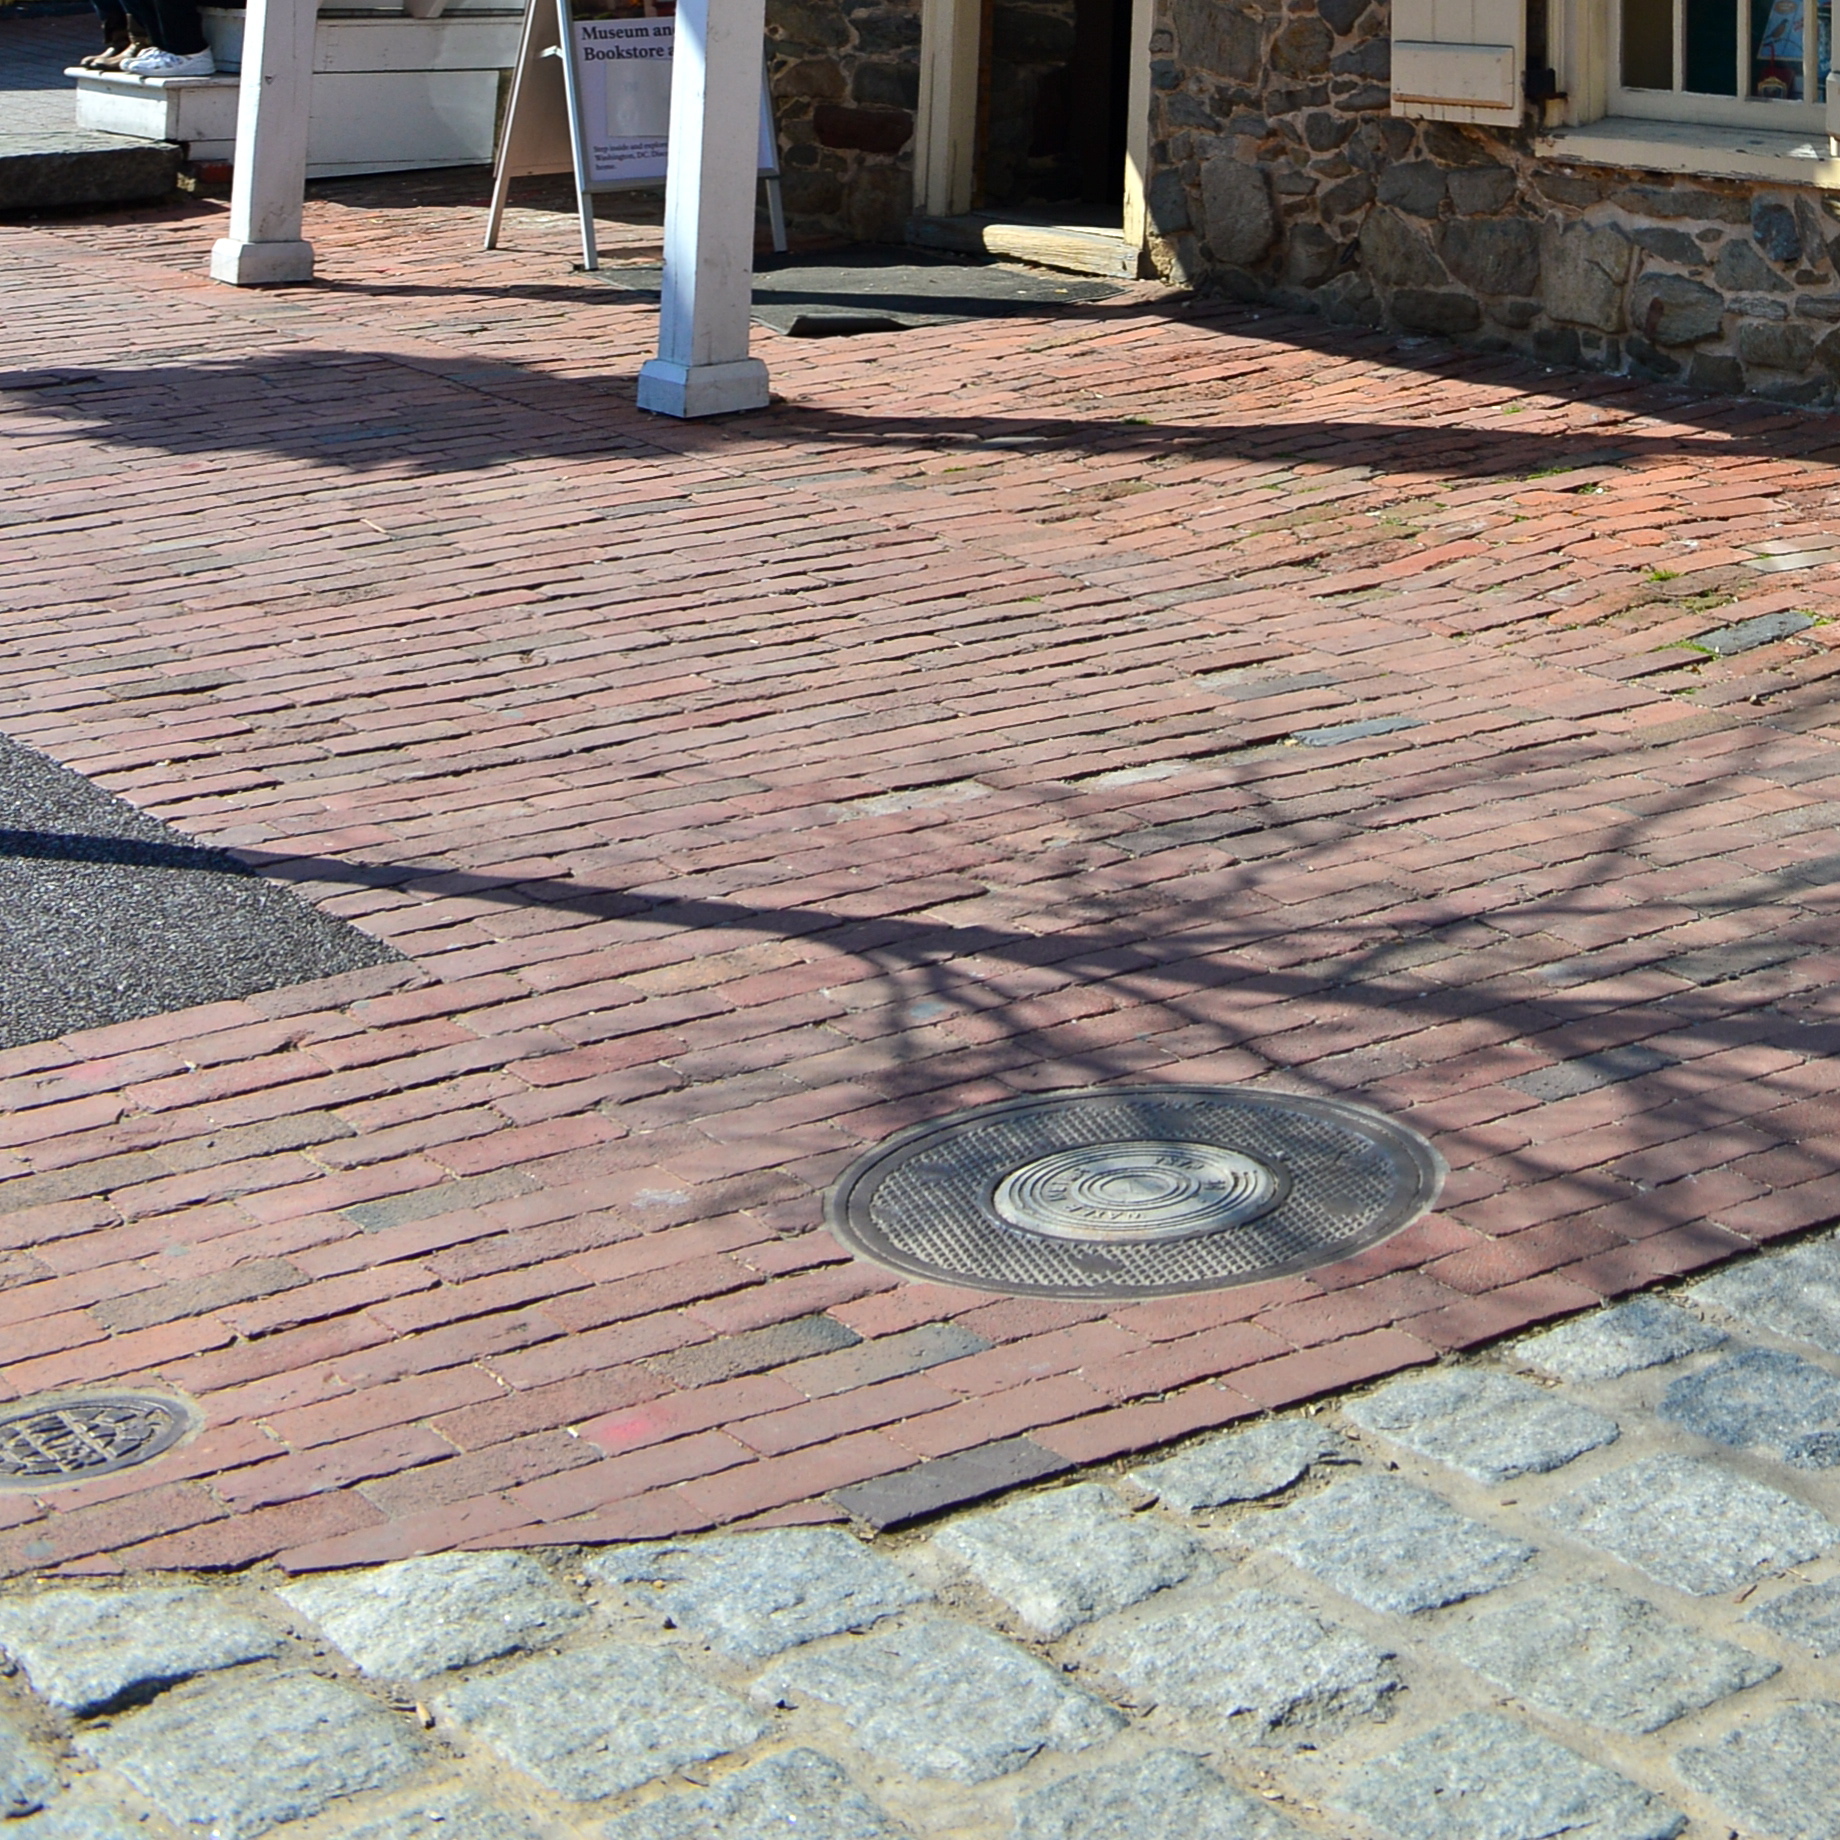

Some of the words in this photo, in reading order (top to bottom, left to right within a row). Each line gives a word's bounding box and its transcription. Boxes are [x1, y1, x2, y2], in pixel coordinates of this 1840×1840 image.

[581, 26, 650, 40] Museum
[652, 25, 674, 37] an
[583, 45, 665, 61] Bookstore
